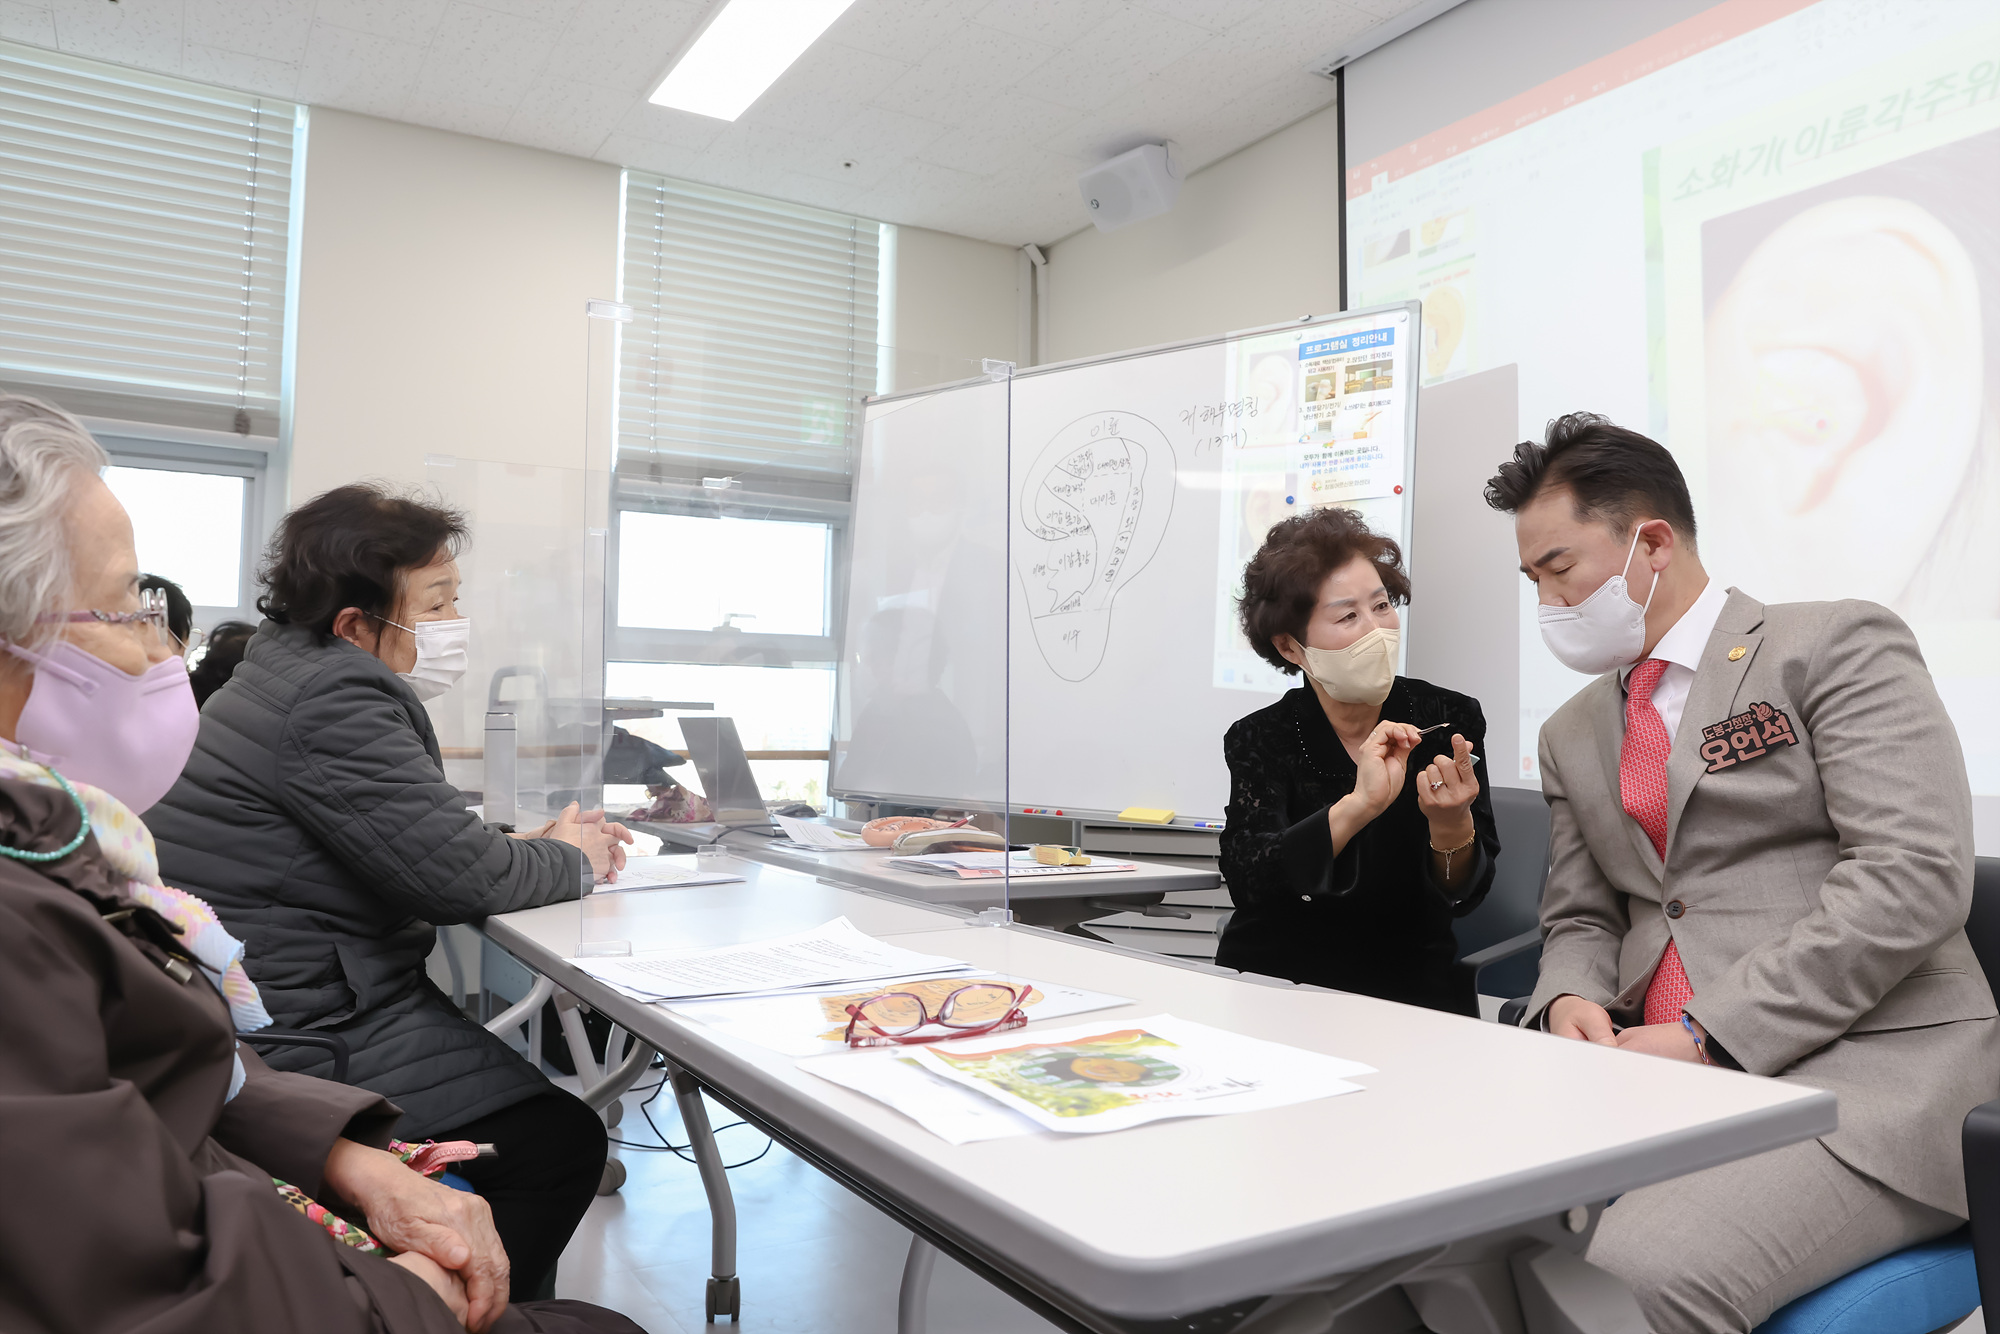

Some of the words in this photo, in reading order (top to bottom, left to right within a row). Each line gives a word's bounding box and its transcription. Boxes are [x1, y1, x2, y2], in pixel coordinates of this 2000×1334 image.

[1305, 339, 1348, 355] 프로그램실
[1352, 332, 1388, 347] 정리안내
[1370, 350, 1393, 360] 의자정리
[1200, 396, 1259, 427] 해부명칭
[1090, 417, 1121, 437] 이륜
[1195, 428, 1248, 457] (13개)
[1303, 453, 1320, 461] 모두가
[1321, 451, 1333, 459] 함께
[1334, 449, 1355, 457] 이용하는
[1089, 490, 1118, 507] 대이륜
[1704, 713, 1755, 740] 도봉구청장
[1701, 714, 1797, 773] 오언석
